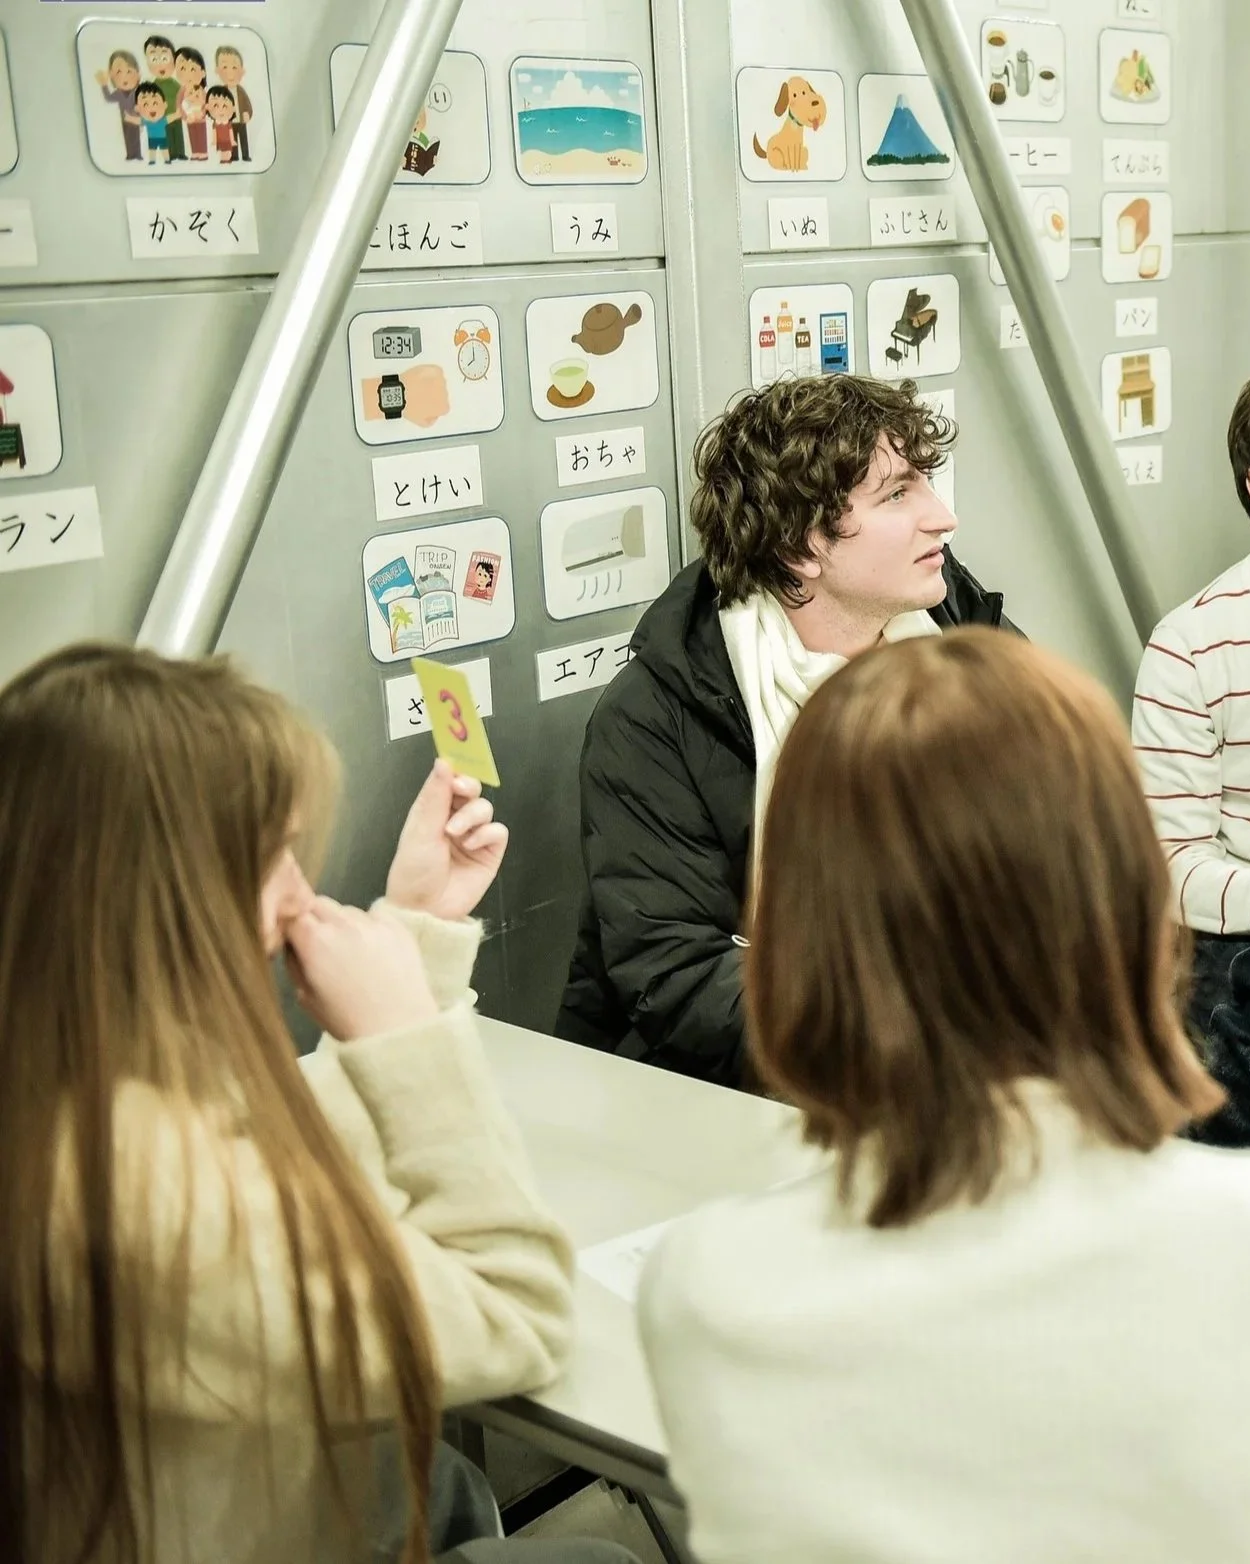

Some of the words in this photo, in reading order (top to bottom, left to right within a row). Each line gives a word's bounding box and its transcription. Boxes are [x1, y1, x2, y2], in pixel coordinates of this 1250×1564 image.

[149, 208, 240, 243] かぞく
[569, 216, 612, 245] うみ
[780, 216, 818, 237] いぬ
[879, 209, 949, 235] ふじさん
[381, 336, 411, 354] 12:34
[760, 334, 775, 343] COLA
[797, 335, 810, 343] TEA
[570, 444, 637, 472] おちゃ
[393, 474, 472, 507] とけい
[419, 551, 449, 563] TRIP
[472, 554, 500, 566] FASHION
[370, 562, 406, 590] TRAVEL
[439, 689, 469, 743] 3
